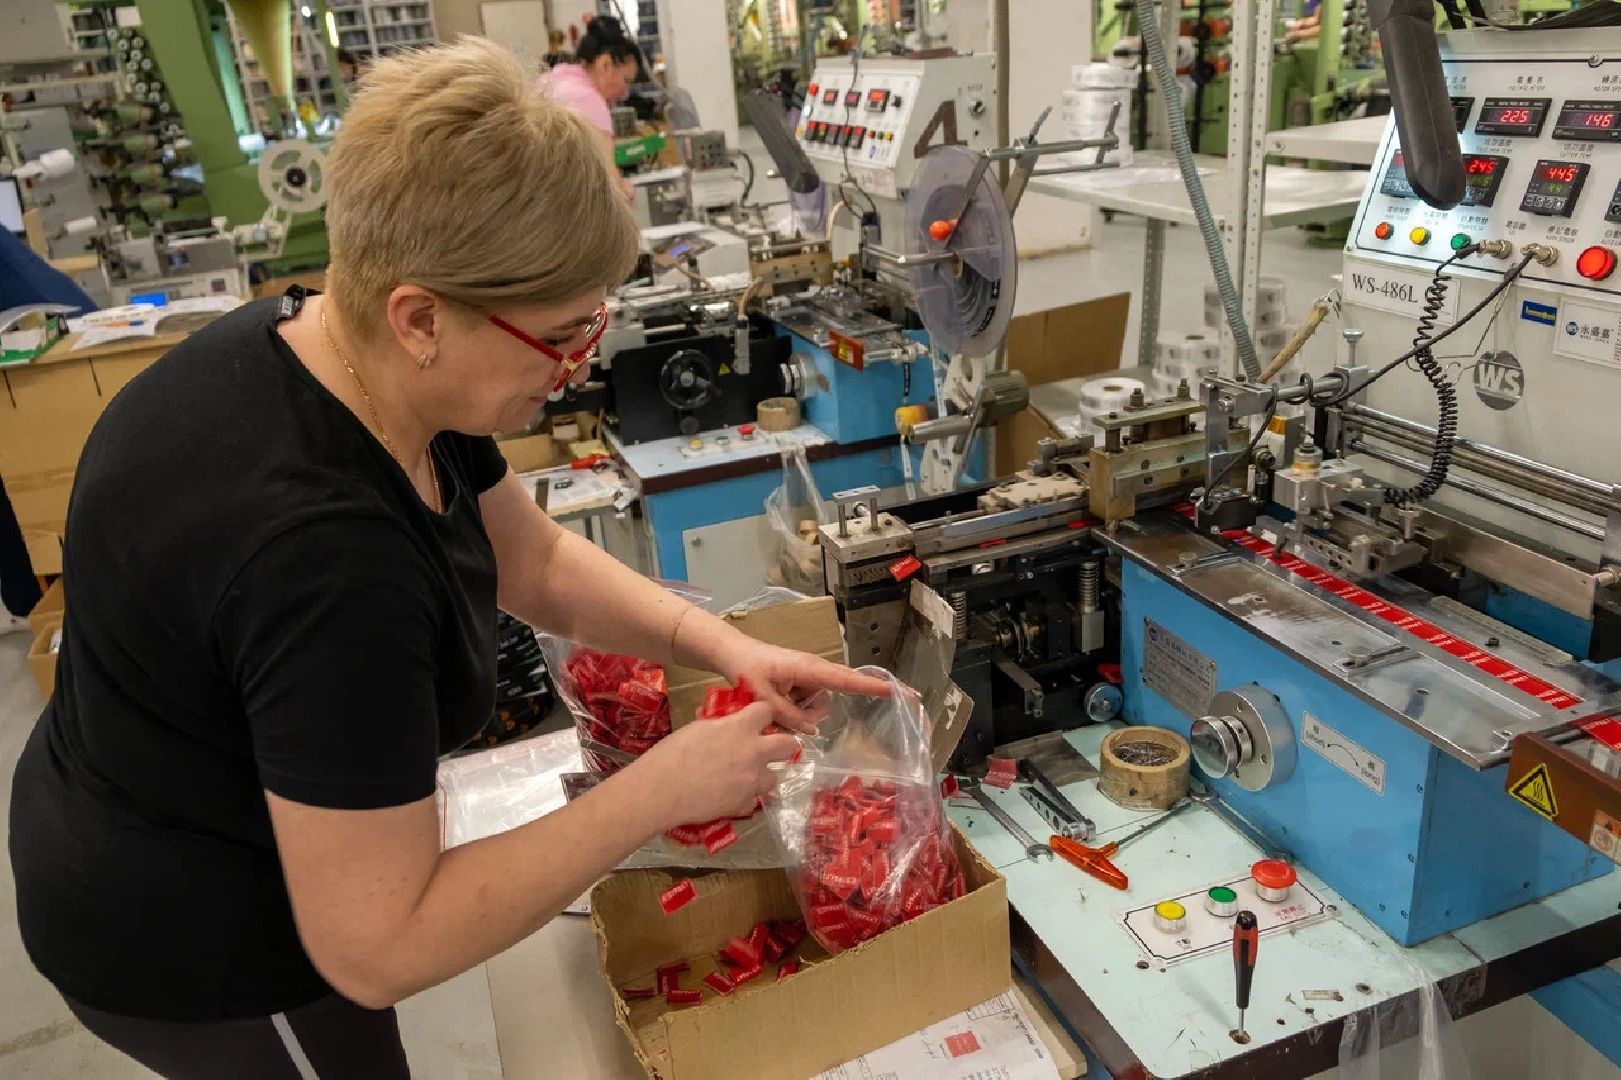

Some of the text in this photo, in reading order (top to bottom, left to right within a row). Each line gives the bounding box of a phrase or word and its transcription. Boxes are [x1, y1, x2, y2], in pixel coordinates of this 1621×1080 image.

[1501, 110, 1529, 123] 225
[1585, 114, 1613, 127] 146
[1469, 160, 1496, 174] 245
[1549, 168, 1576, 182] 445
[1353, 273, 1418, 303] WS-486L
[1478, 364, 1521, 397] WS
